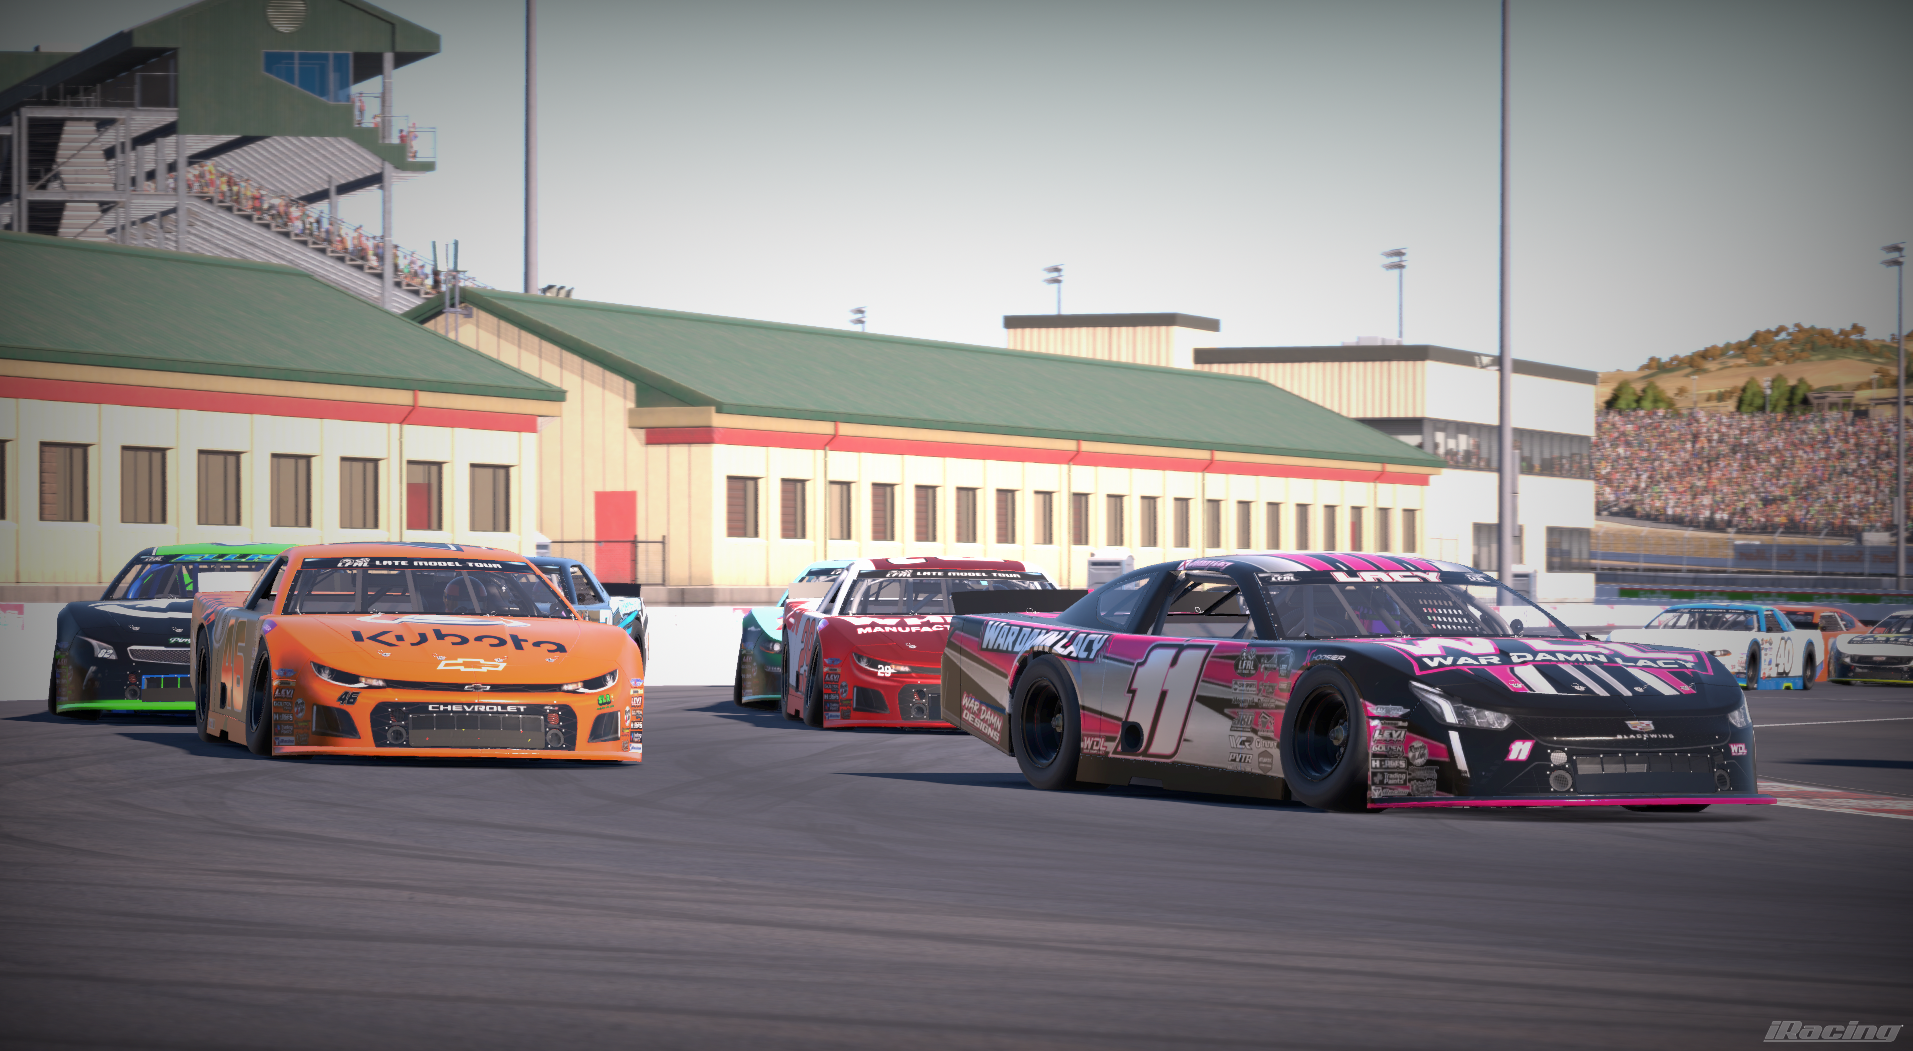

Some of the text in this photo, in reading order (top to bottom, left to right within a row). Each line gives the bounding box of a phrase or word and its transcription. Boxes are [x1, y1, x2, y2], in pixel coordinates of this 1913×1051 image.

[1331, 572, 1442, 582] LACY
[350, 629, 568, 653] Kubota
[1421, 652, 1699, 668] WAR DAMN LACY
[1776, 635, 1795, 677] 40
[878, 665, 892, 676] 29
[336, 690, 361, 705] 46
[1111, 644, 1215, 760] 11
[962, 693, 1003, 732] WAR DAMN
[962, 710, 1001, 743] DESIGNS
[1373, 729, 1406, 741] LEVI
[1082, 737, 1107, 750] WDL
[1508, 740, 1533, 761] 11
[1730, 744, 1748, 753] WDL
[1384, 772, 1406, 781] Trading
